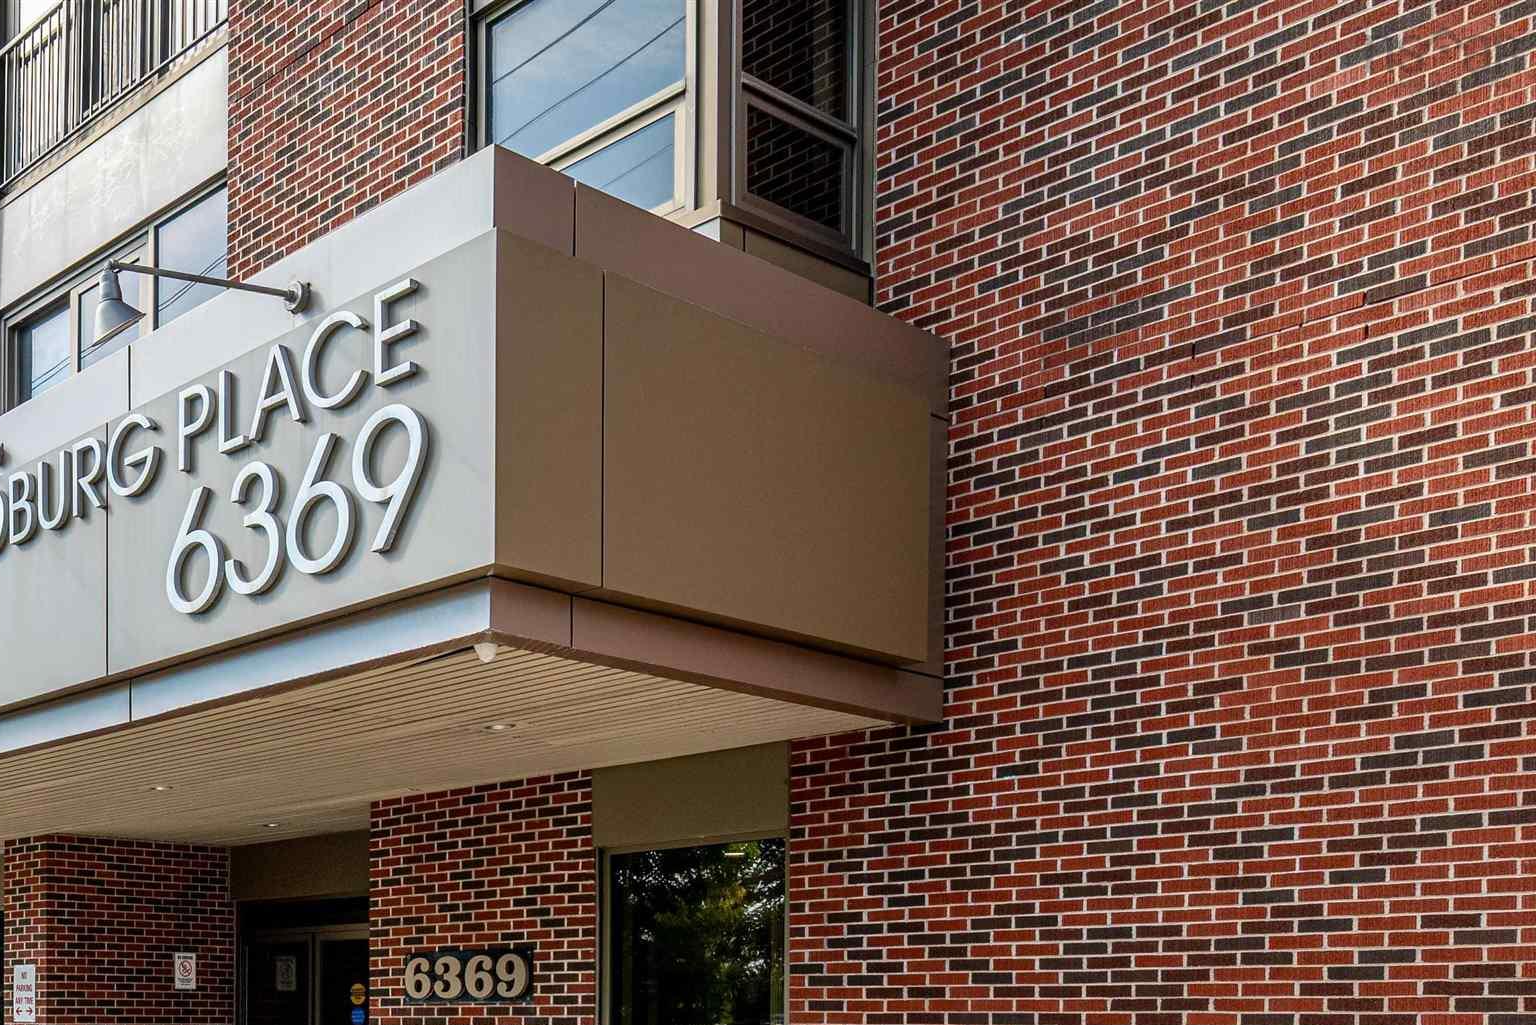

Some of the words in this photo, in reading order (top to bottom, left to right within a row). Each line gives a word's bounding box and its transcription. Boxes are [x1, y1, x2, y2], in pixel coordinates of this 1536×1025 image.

[177, 277, 420, 471] PLACE
[166, 403, 430, 614] 6369
[404, 953, 526, 999] 6369
